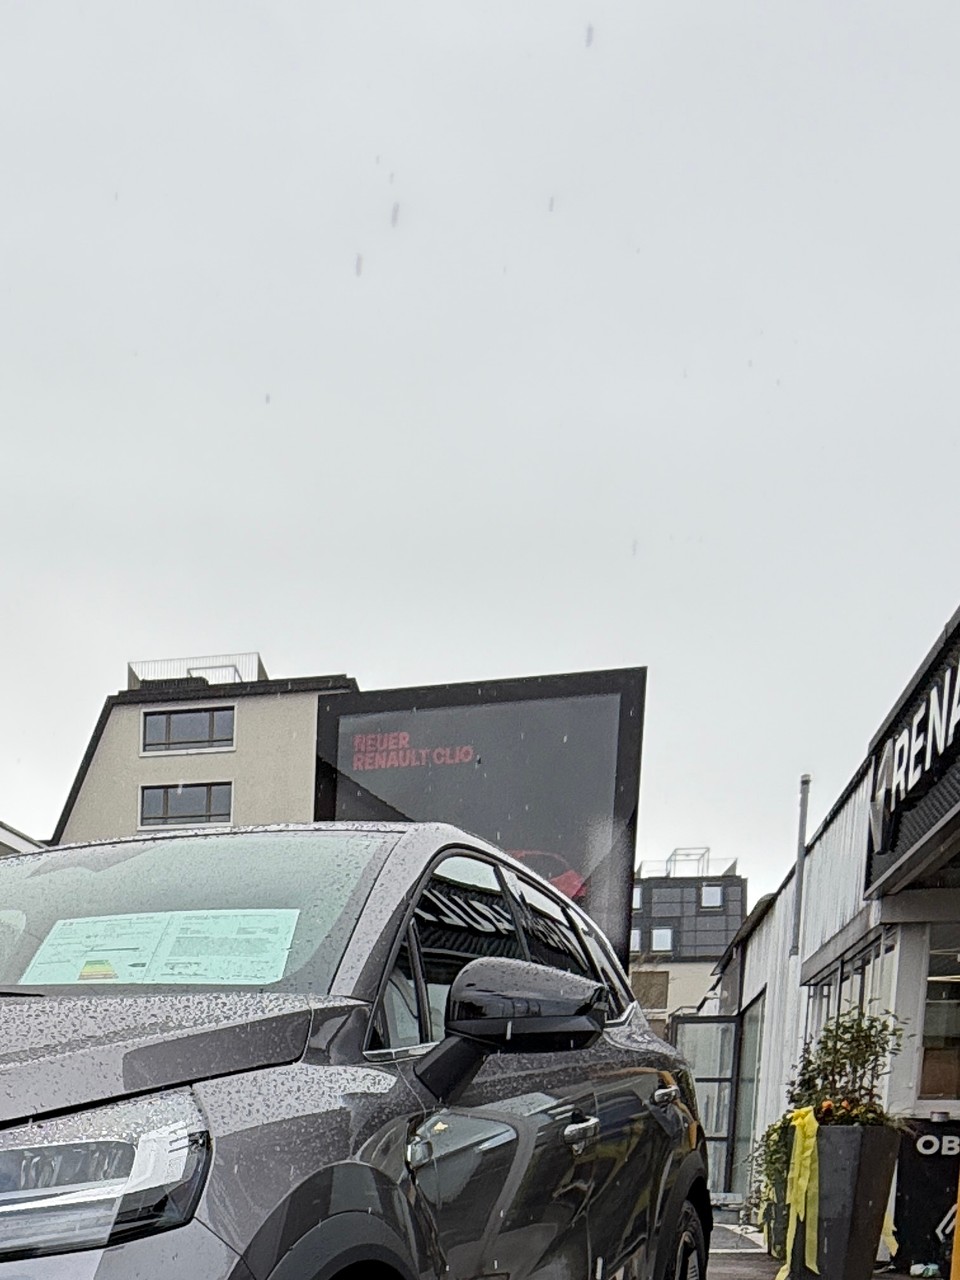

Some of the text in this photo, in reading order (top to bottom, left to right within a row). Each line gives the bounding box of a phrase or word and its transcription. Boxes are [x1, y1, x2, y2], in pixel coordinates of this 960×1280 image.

[353, 732, 410, 751] NEUER
[353, 746, 472, 770] RENAULT CLIO
